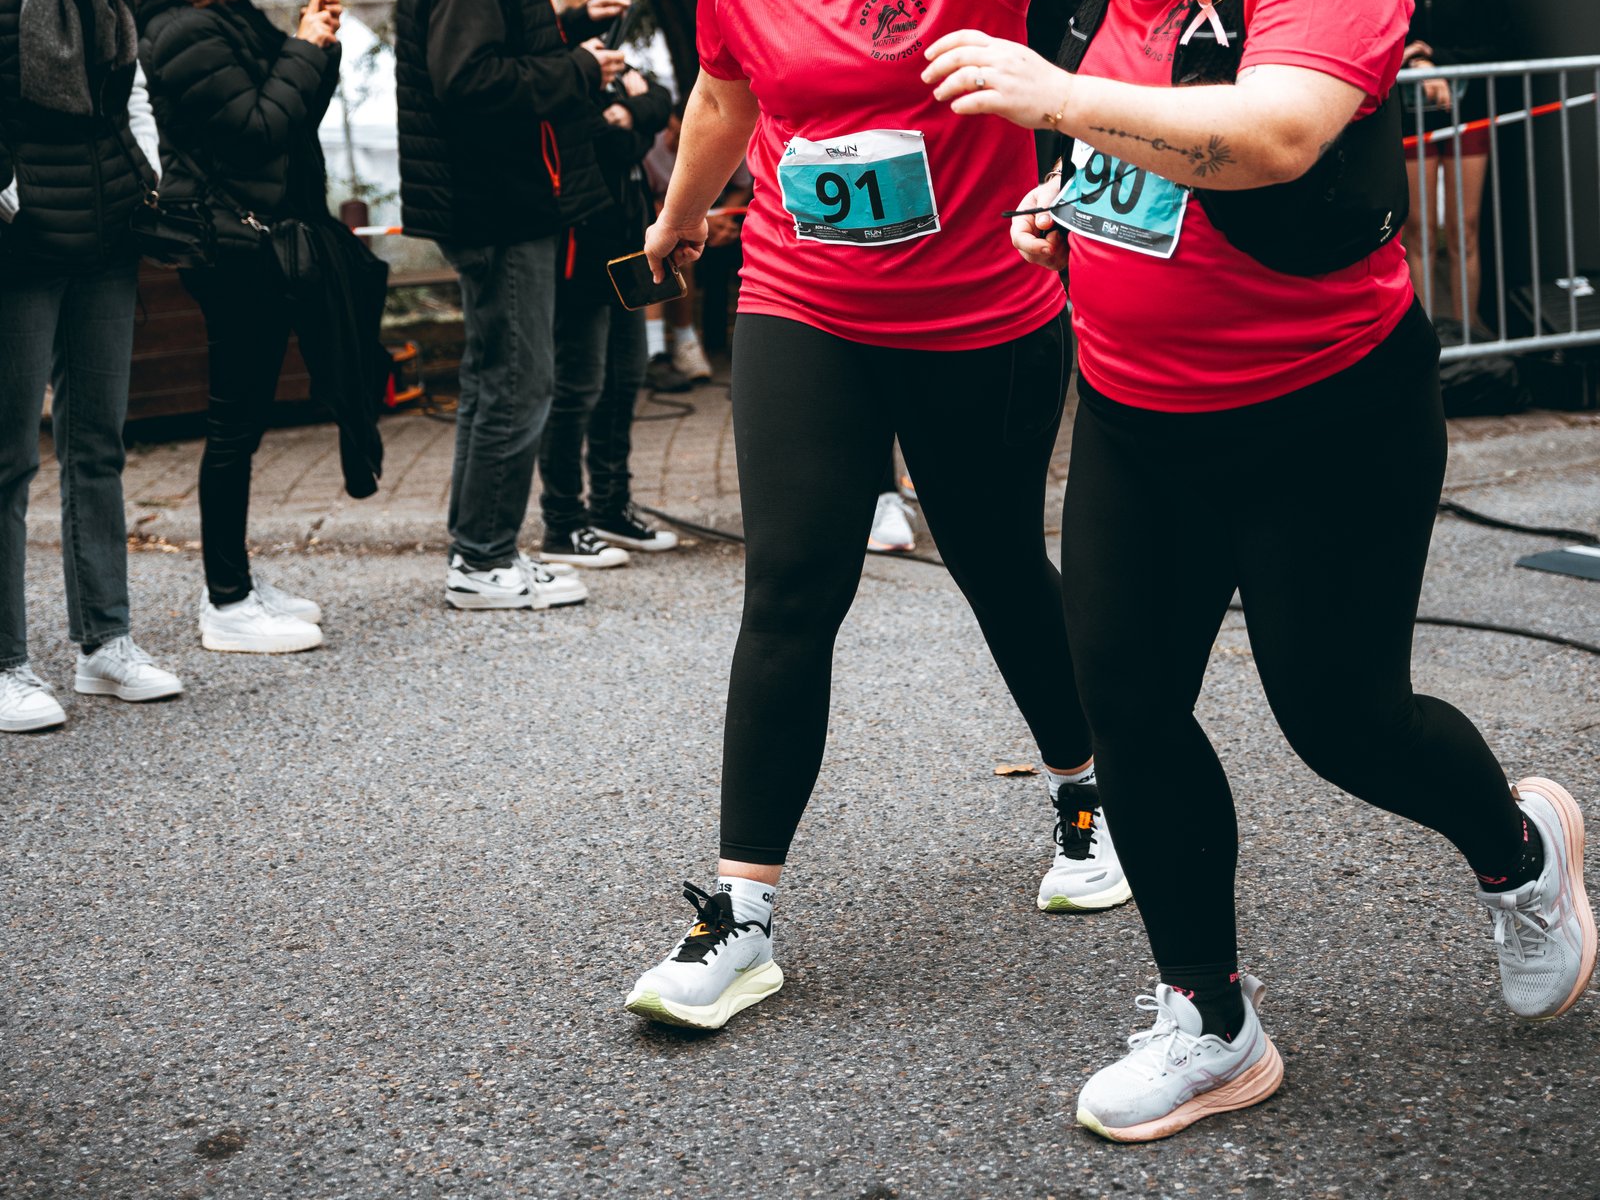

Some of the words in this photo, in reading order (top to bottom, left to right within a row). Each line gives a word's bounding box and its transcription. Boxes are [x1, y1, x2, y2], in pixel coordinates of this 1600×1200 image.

[826, 144, 858, 158] RUN
[815, 169, 886, 224] 91
[1080, 149, 1147, 215] 90
